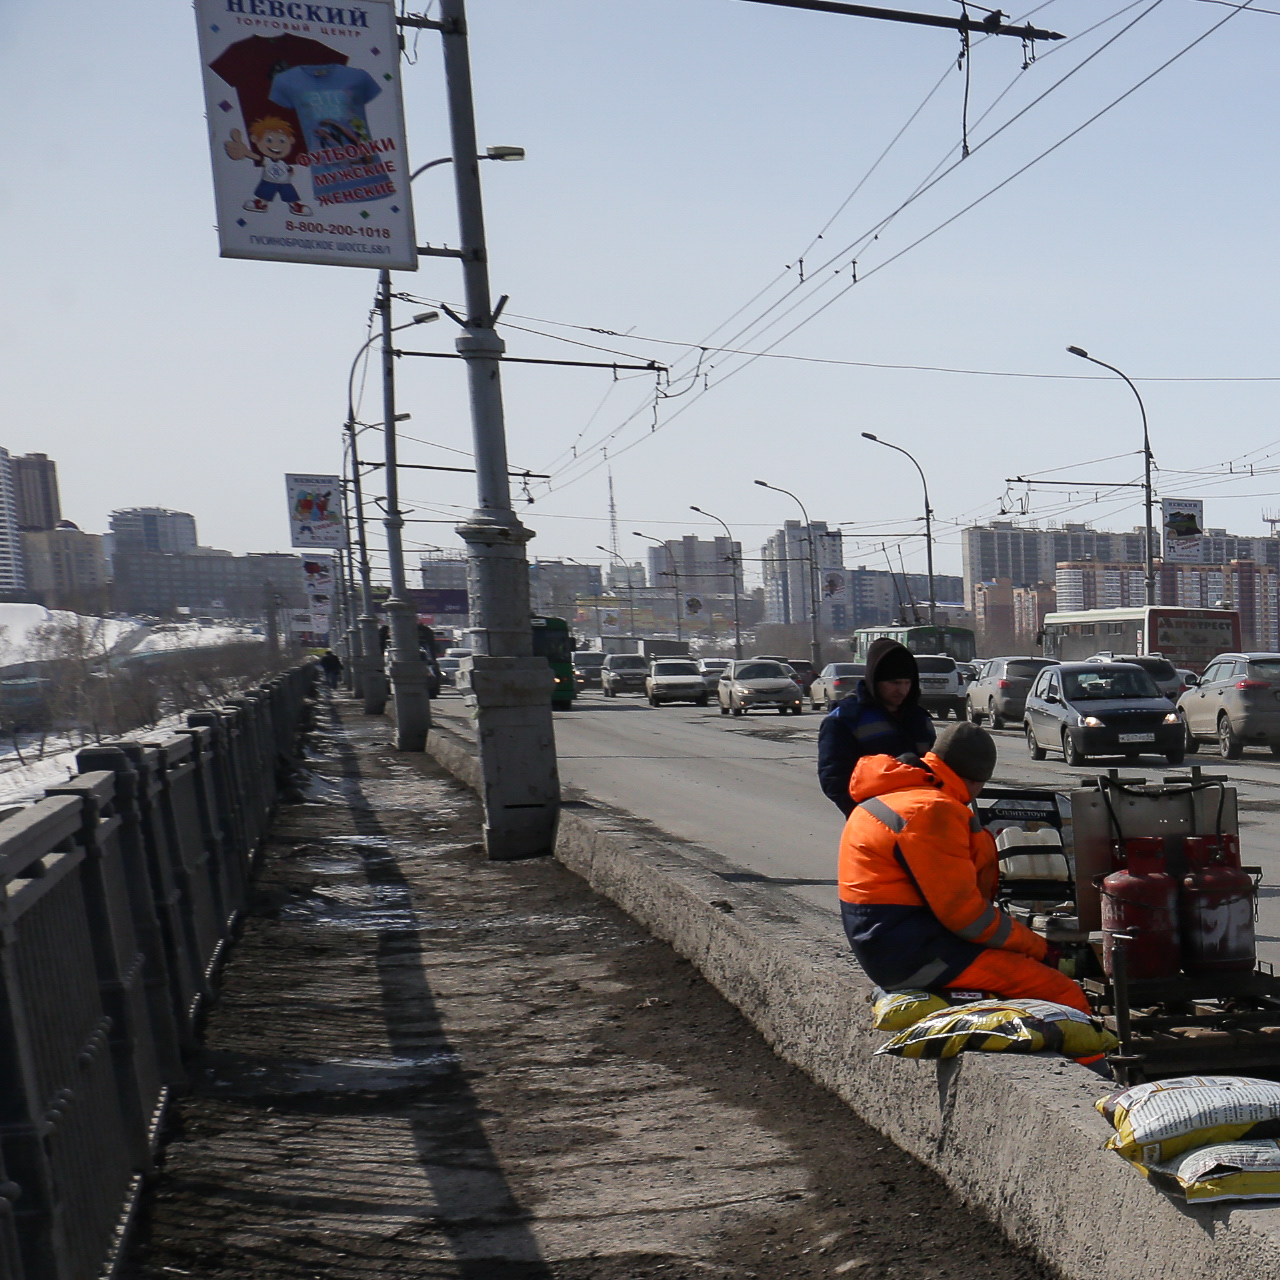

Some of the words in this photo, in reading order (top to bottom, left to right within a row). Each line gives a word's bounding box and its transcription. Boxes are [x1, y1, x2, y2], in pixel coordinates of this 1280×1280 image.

[226, 0, 369, 28] НЕВСКИЙ
[236, 17, 310, 33] ТОРГОВЫЙ
[320, 26, 362, 38] ЦЕНТР
[296, 137, 396, 168] ФУТБОЛКИ
[314, 160, 396, 187] МУЖСКИЕ
[316, 181, 397, 207] ЖЕНСКИЕ
[285, 219, 391, 239] 8-800-200-1018
